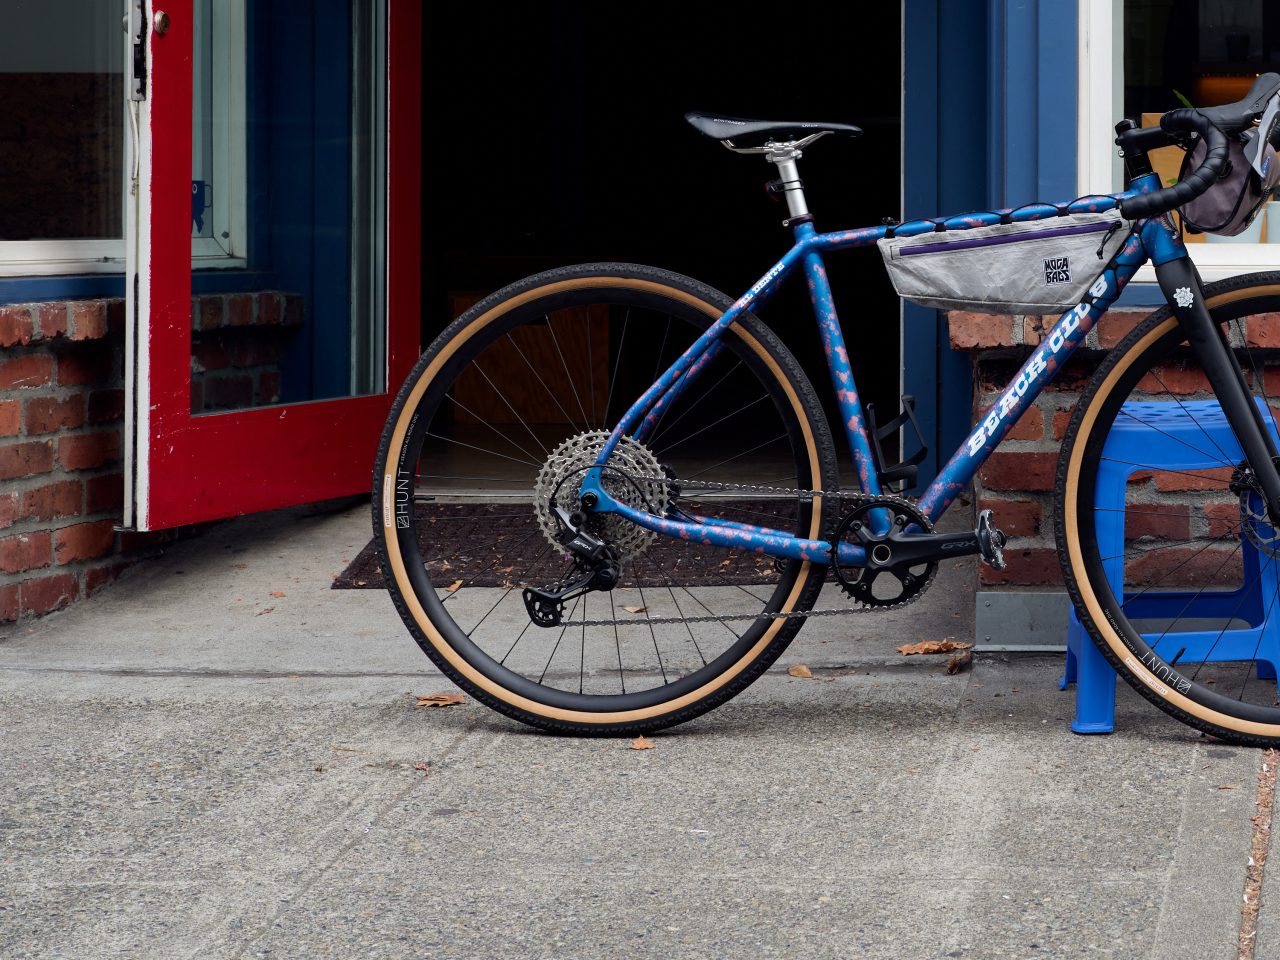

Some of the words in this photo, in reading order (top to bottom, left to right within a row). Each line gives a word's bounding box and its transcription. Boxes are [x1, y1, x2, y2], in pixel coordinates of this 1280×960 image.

[1044, 257, 1069, 271] MOGA
[1045, 269, 1070, 283] BAGS
[967, 351, 1047, 457] BEACH
[1049, 273, 1108, 354] CLUB
[396, 466, 411, 514] HUNT
[940, 539, 977, 551] GRX
[1138, 651, 1180, 686] HUNT
